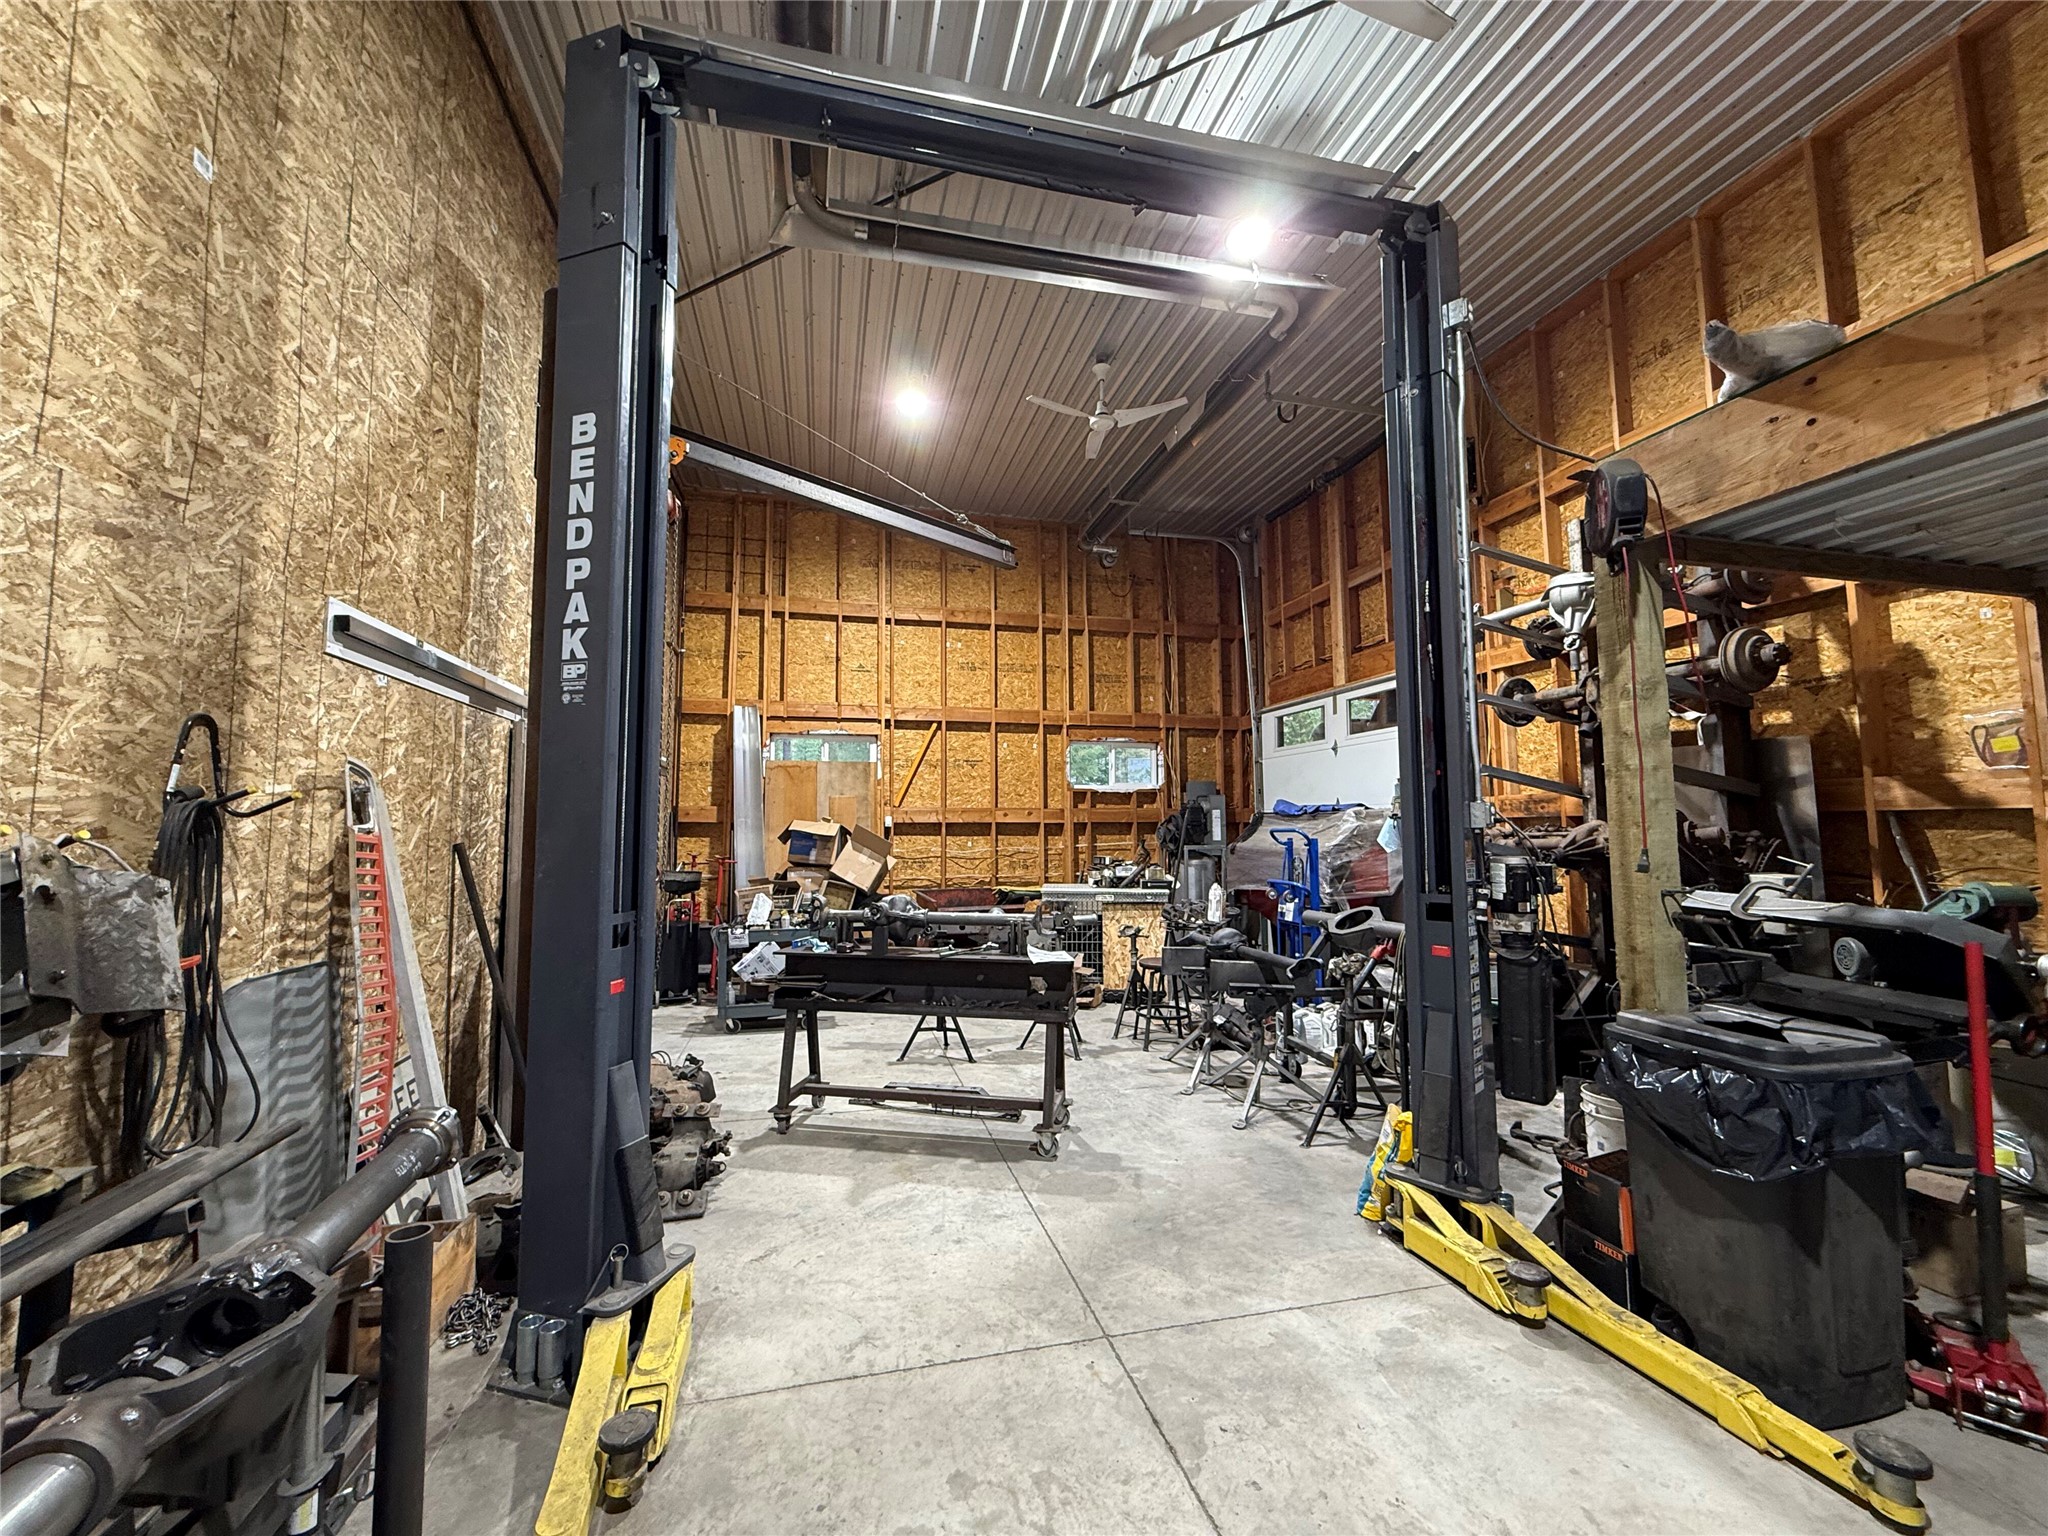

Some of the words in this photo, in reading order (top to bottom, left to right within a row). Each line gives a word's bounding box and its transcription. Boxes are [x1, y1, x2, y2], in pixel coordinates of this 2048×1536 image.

[561, 412, 597, 661] BENDPAK
[562, 663, 587, 679] BP
[1563, 1159, 1589, 1178] TIMKEN
[1594, 1240, 1624, 1262] TIMKEN
